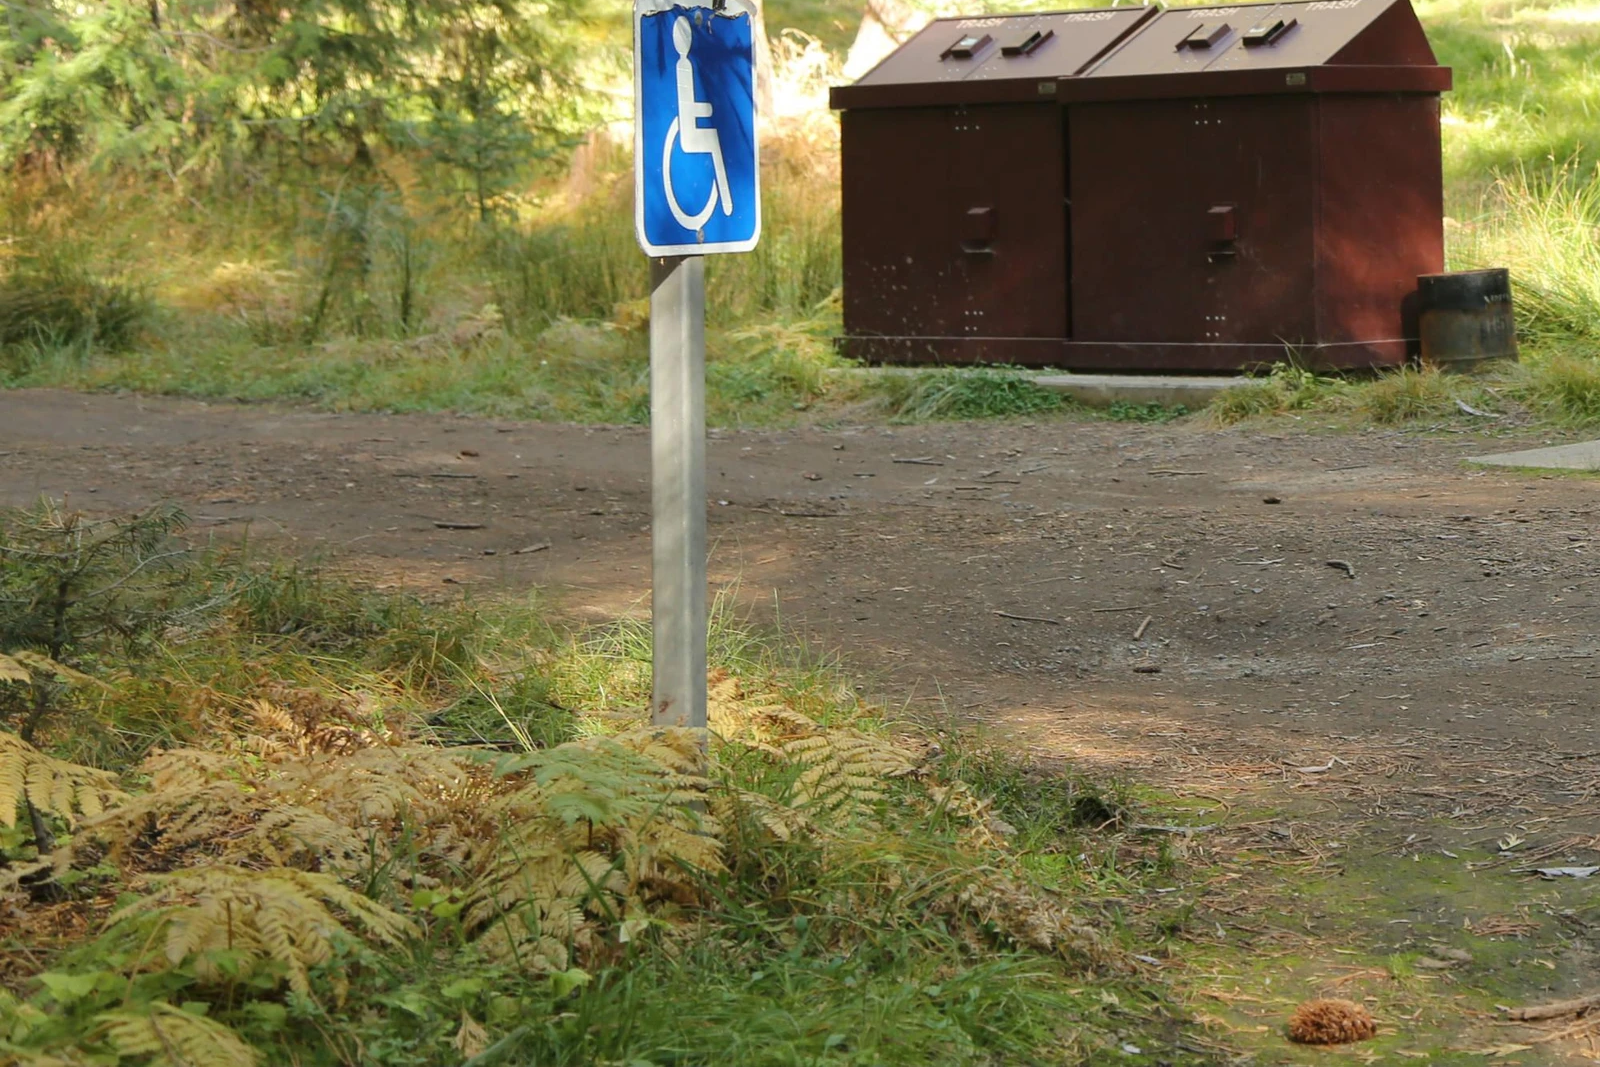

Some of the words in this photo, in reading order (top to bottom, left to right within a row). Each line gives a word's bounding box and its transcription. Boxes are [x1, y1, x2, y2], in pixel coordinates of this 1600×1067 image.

[1063, 11, 1117, 23] TRASH
[1187, 7, 1241, 19] TRASH
[956, 17, 1008, 29] TRASH
